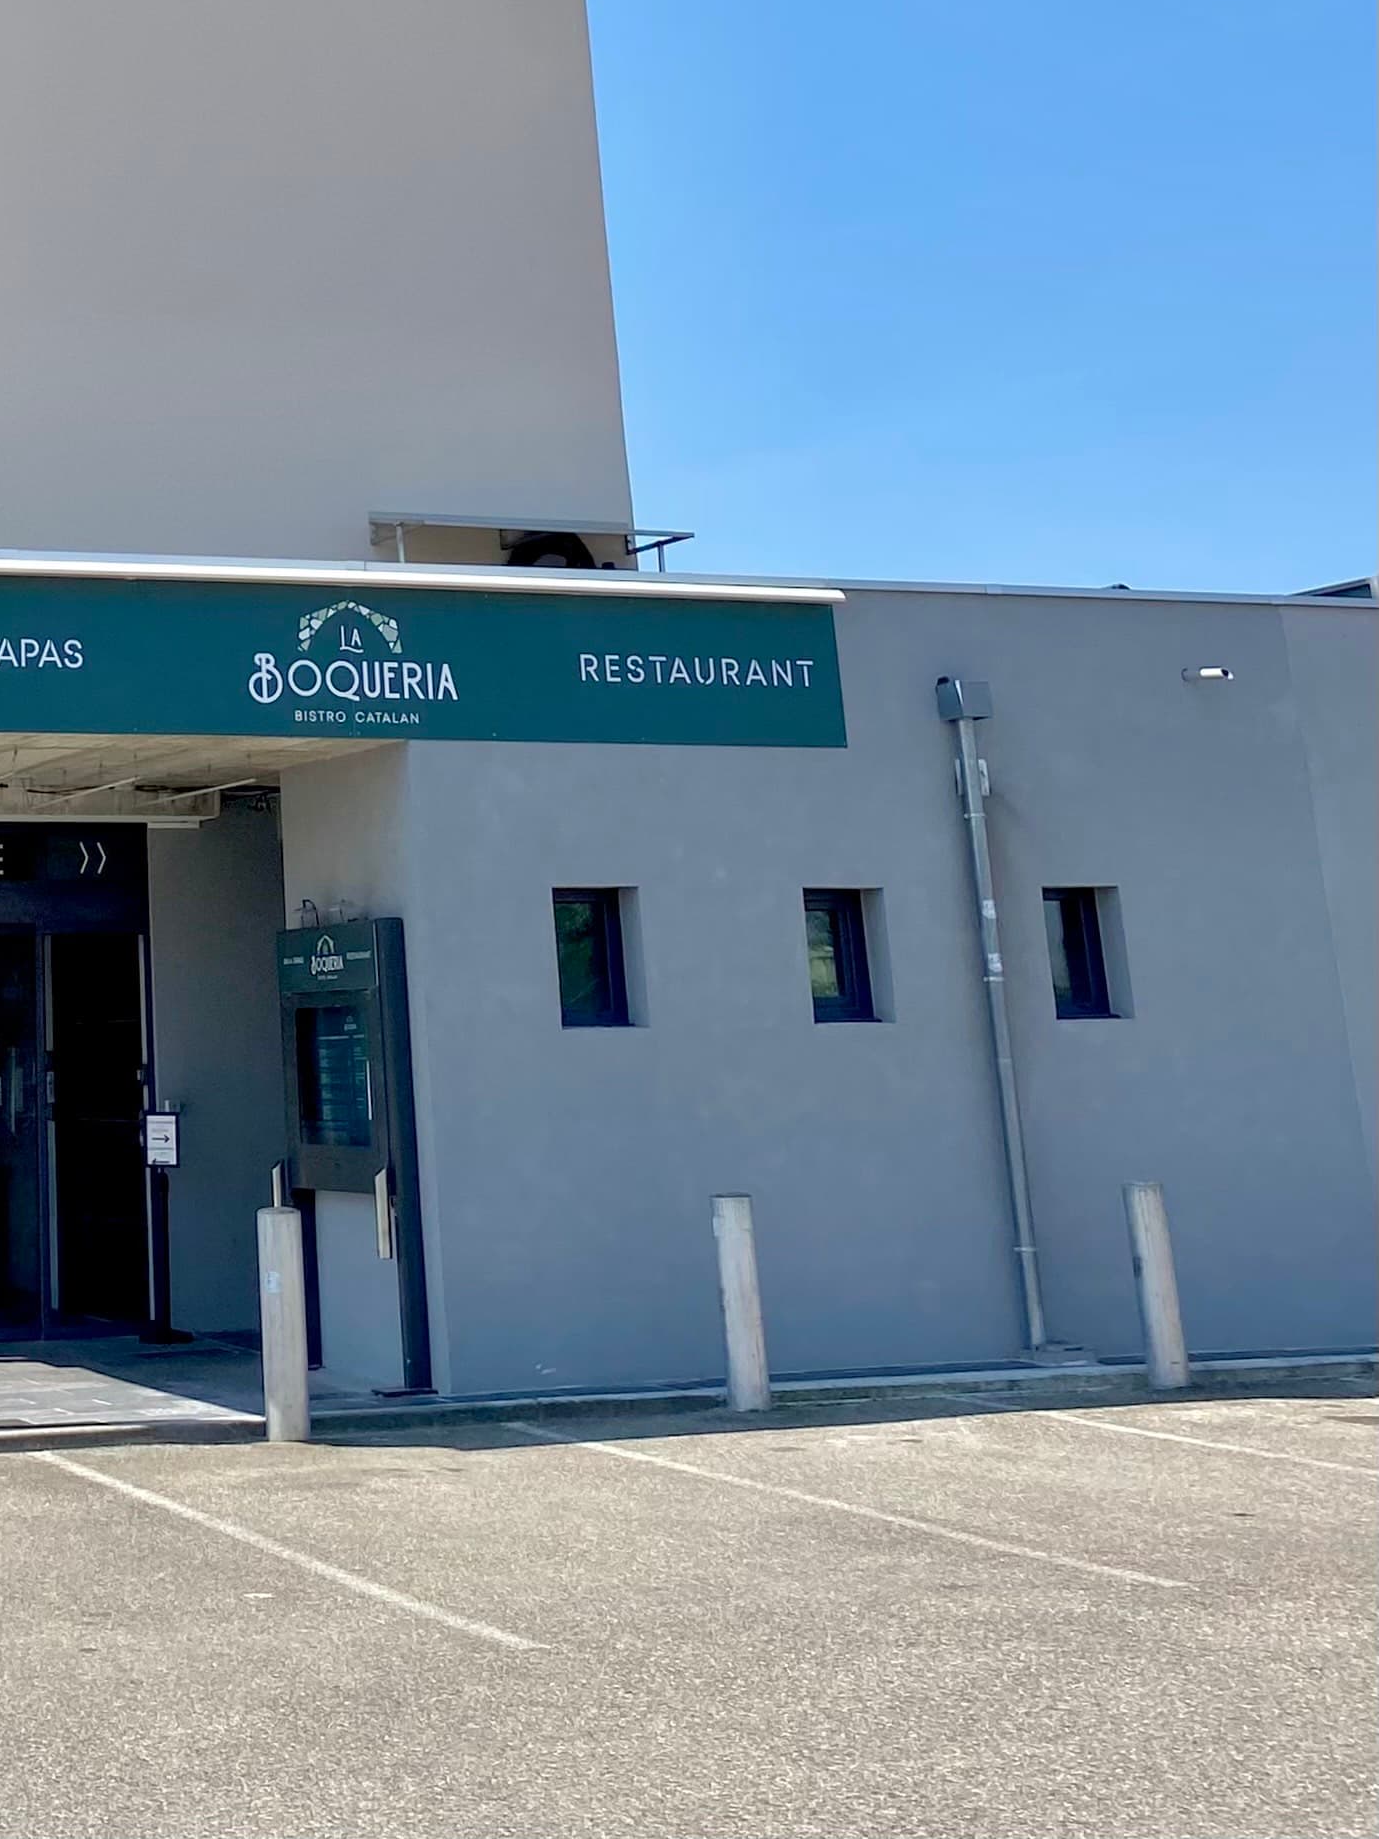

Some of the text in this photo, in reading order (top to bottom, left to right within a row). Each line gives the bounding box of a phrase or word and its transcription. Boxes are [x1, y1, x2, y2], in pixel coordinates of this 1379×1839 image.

[339, 625, 364, 654] LA
[248, 652, 459, 704] BOQUERIA
[579, 653, 814, 688] RESTAURANT
[294, 709, 420, 724] BISTRO CATALAN
